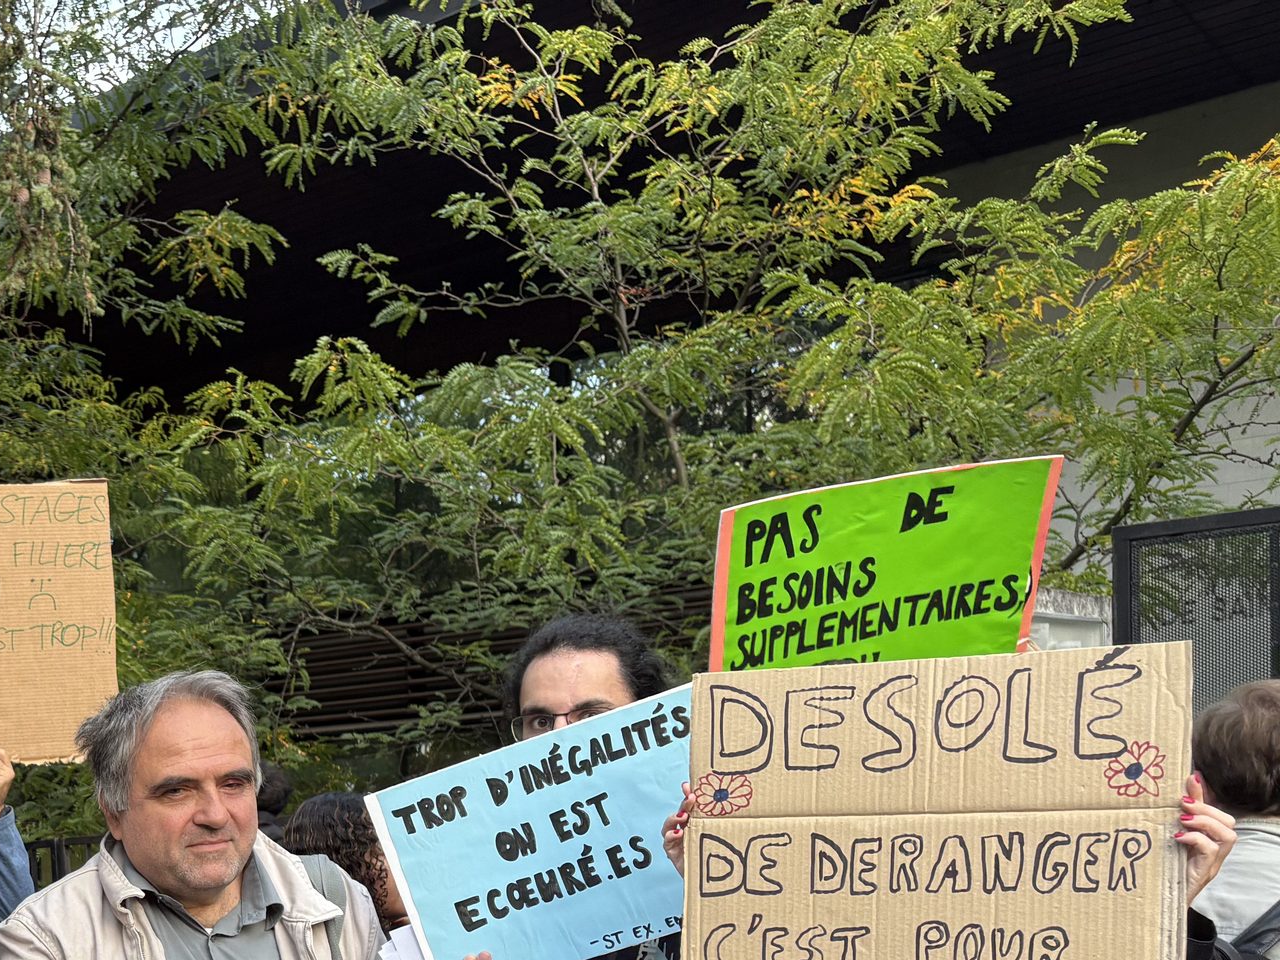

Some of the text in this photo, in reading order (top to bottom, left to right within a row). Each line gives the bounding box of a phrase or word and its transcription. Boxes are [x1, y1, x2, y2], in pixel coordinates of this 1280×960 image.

[744, 486, 954, 568] PAS DE
[736, 556, 876, 626] BESOINS
[709, 645, 1142, 774] DESOLÉ
[391, 703, 691, 835] TROP D'INÉGALITÉS
[495, 792, 609, 862] ON EST
[699, 828, 1153, 897] DE DERANGER
